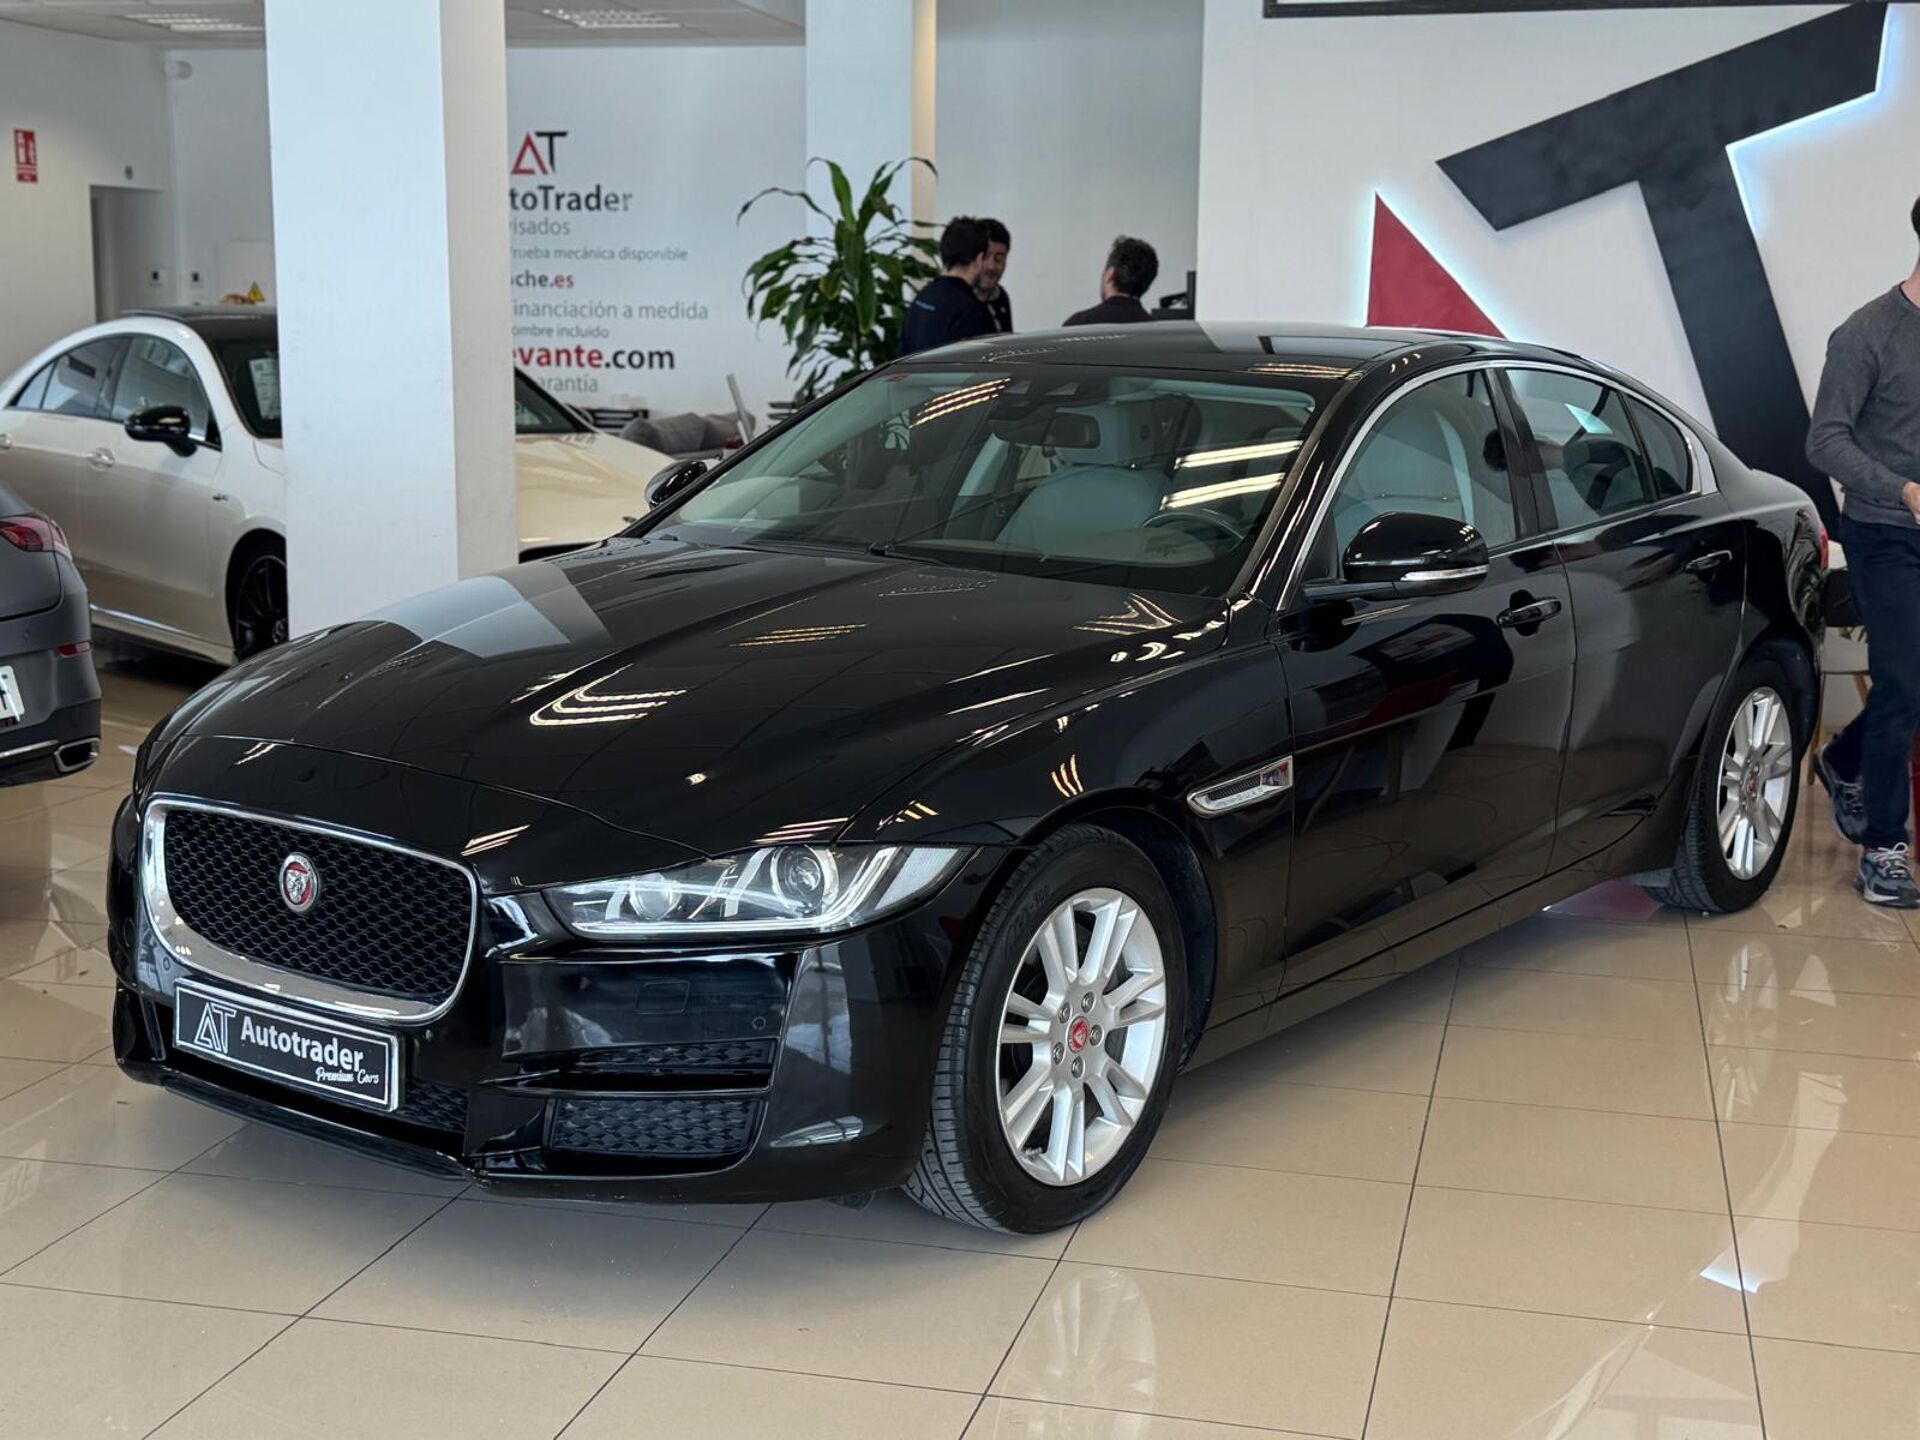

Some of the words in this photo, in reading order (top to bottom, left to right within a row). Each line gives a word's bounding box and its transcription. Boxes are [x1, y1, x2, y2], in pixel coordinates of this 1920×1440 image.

[511, 131, 568, 175] AT
[509, 184, 633, 211] toTrader
[512, 247, 550, 259] rueba
[553, 246, 615, 259] mecánica
[618, 246, 688, 262] disponible
[512, 299, 618, 318] inanciación
[623, 305, 633, 318] a
[638, 301, 709, 319] medida
[512, 324, 554, 337] ombre
[556, 325, 610, 338] incluido
[513, 345, 675, 369] vante.com
[193, 1002, 237, 1054] AT
[240, 1016, 363, 1069] Autotrader
[316, 1066, 354, 1083] Premium
[357, 1069, 380, 1085] Cars
